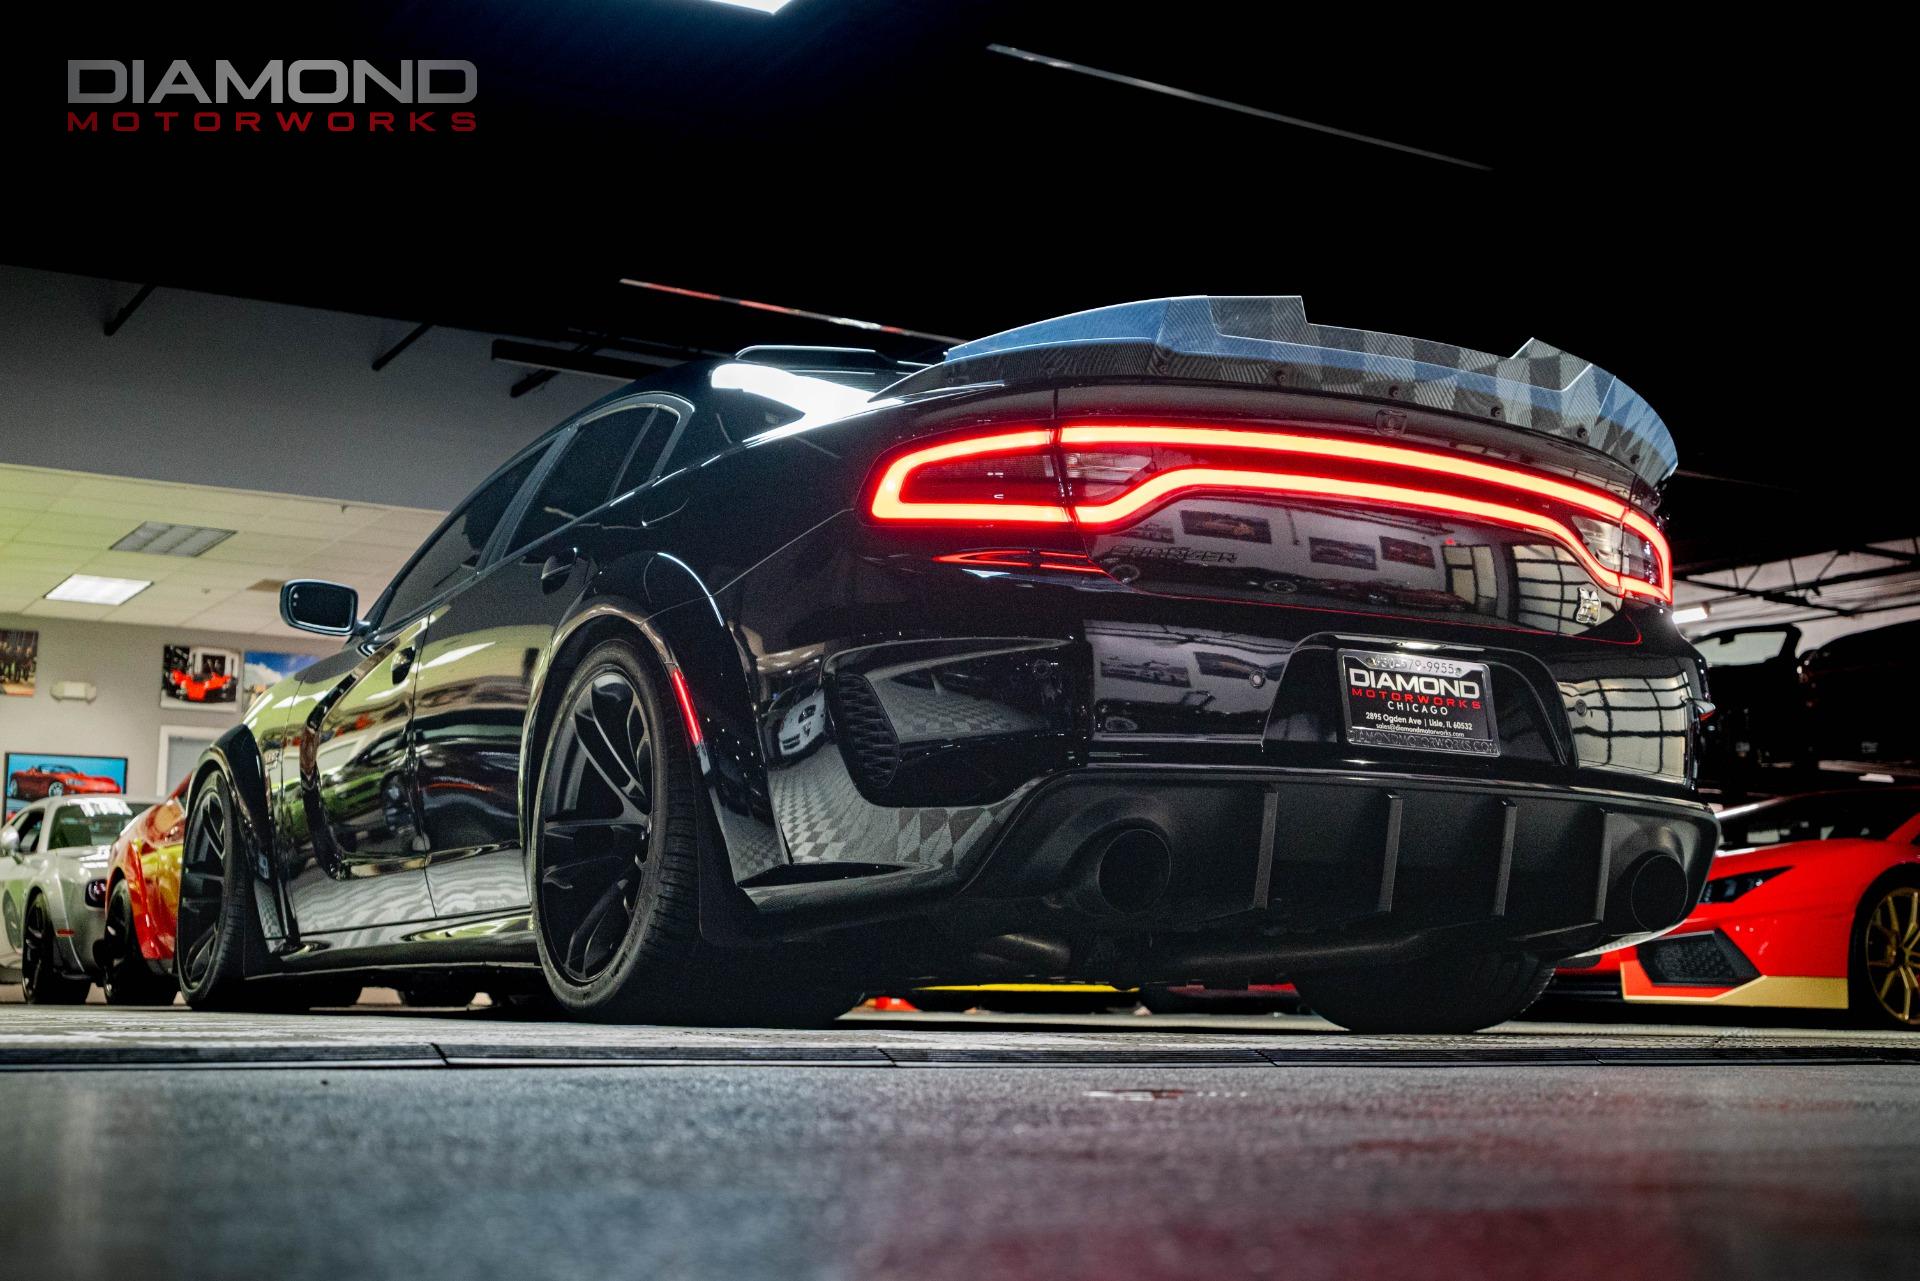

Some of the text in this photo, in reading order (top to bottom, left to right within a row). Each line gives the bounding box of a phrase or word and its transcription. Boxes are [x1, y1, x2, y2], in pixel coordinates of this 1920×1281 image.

[1349, 668, 1480, 699] DIAMOND
[1351, 688, 1481, 709] MOTORWORKS
[1387, 700, 1448, 715] CHICAGO
[1365, 712, 1382, 721] 2895
[1383, 713, 1407, 724] Ogden
[1408, 716, 1422, 725] Ave
[1453, 721, 1473, 730] 60532
[1376, 723, 1465, 737] sales@diamondmotorworks.com
